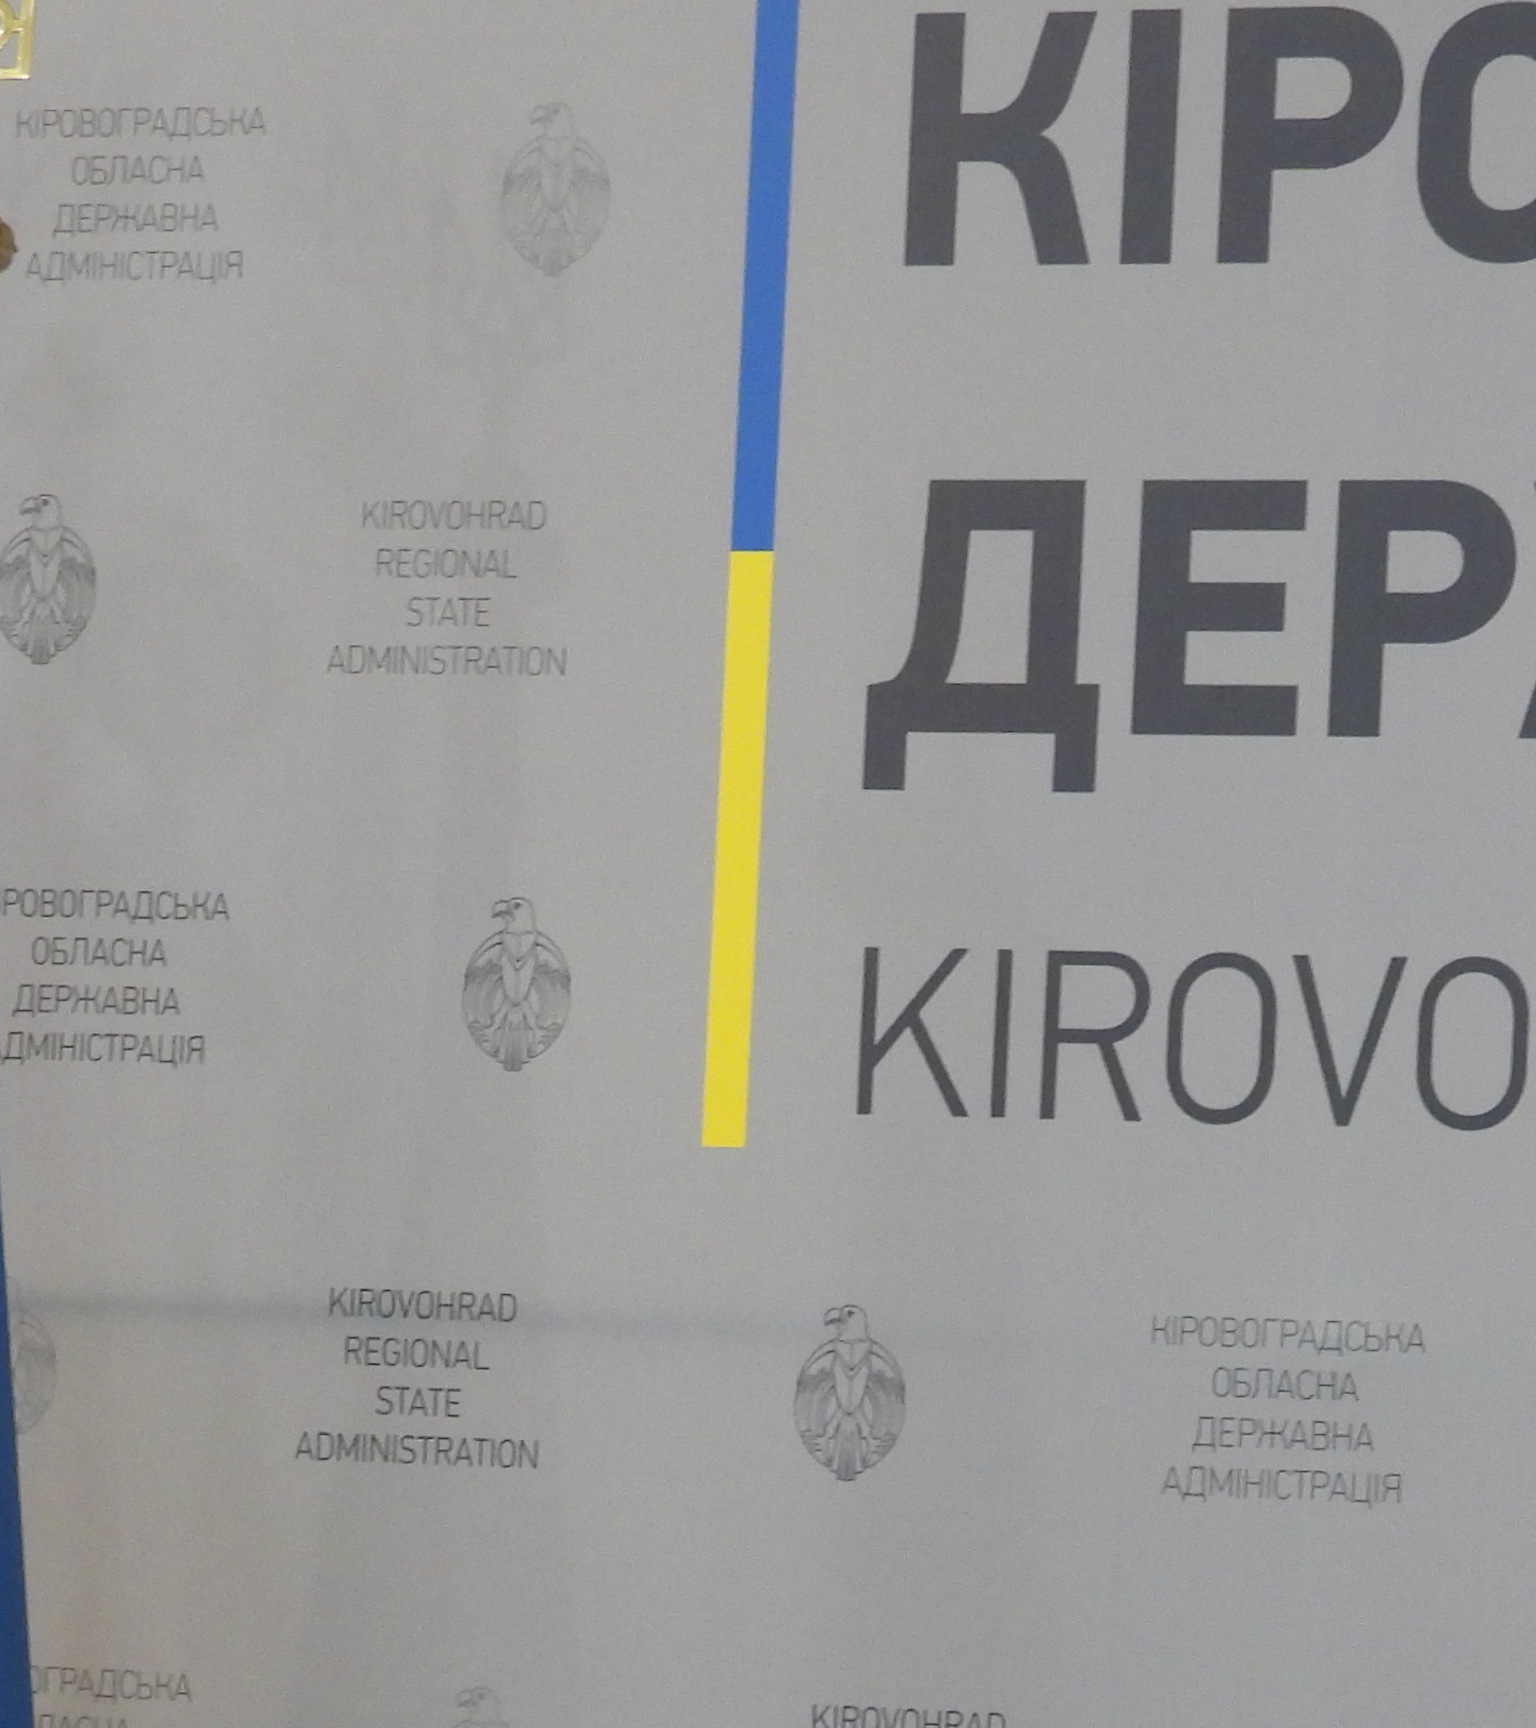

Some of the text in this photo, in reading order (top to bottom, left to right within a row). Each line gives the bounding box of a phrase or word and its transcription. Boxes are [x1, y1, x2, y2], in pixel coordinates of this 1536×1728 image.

[16, 107, 266, 141] КІРОВОГРАДСЬКА
[72, 155, 203, 186] ОБЛАСНА
[52, 203, 218, 238] ДЕРЖАВНА
[25, 250, 243, 284] АДМІНІСТРАЦІЯ
[362, 500, 546, 530] KIROVOHRAD
[376, 548, 517, 579] REGIONAL
[407, 597, 491, 627] STATE
[328, 645, 566, 676] ADMINISTRATION
[32, 936, 166, 967] ОБЛАСНА
[12, 984, 179, 1017] ДЕРЖАВНА
[329, 1288, 516, 1322] KIROVOHRAD
[1151, 1316, 1425, 1354] КІРОВОГРАДСЬКА
[345, 1336, 490, 1370] REGIONAL
[1212, 1367, 1359, 1401] ОБЛАСНА
[375, 1386, 461, 1418] STATE
[295, 1431, 538, 1468] ADMINISTRATION
[1192, 1416, 1374, 1451] ДЕРЖАВНА
[1162, 1466, 1401, 1508] АДМІНІСТРАЦІЯ
